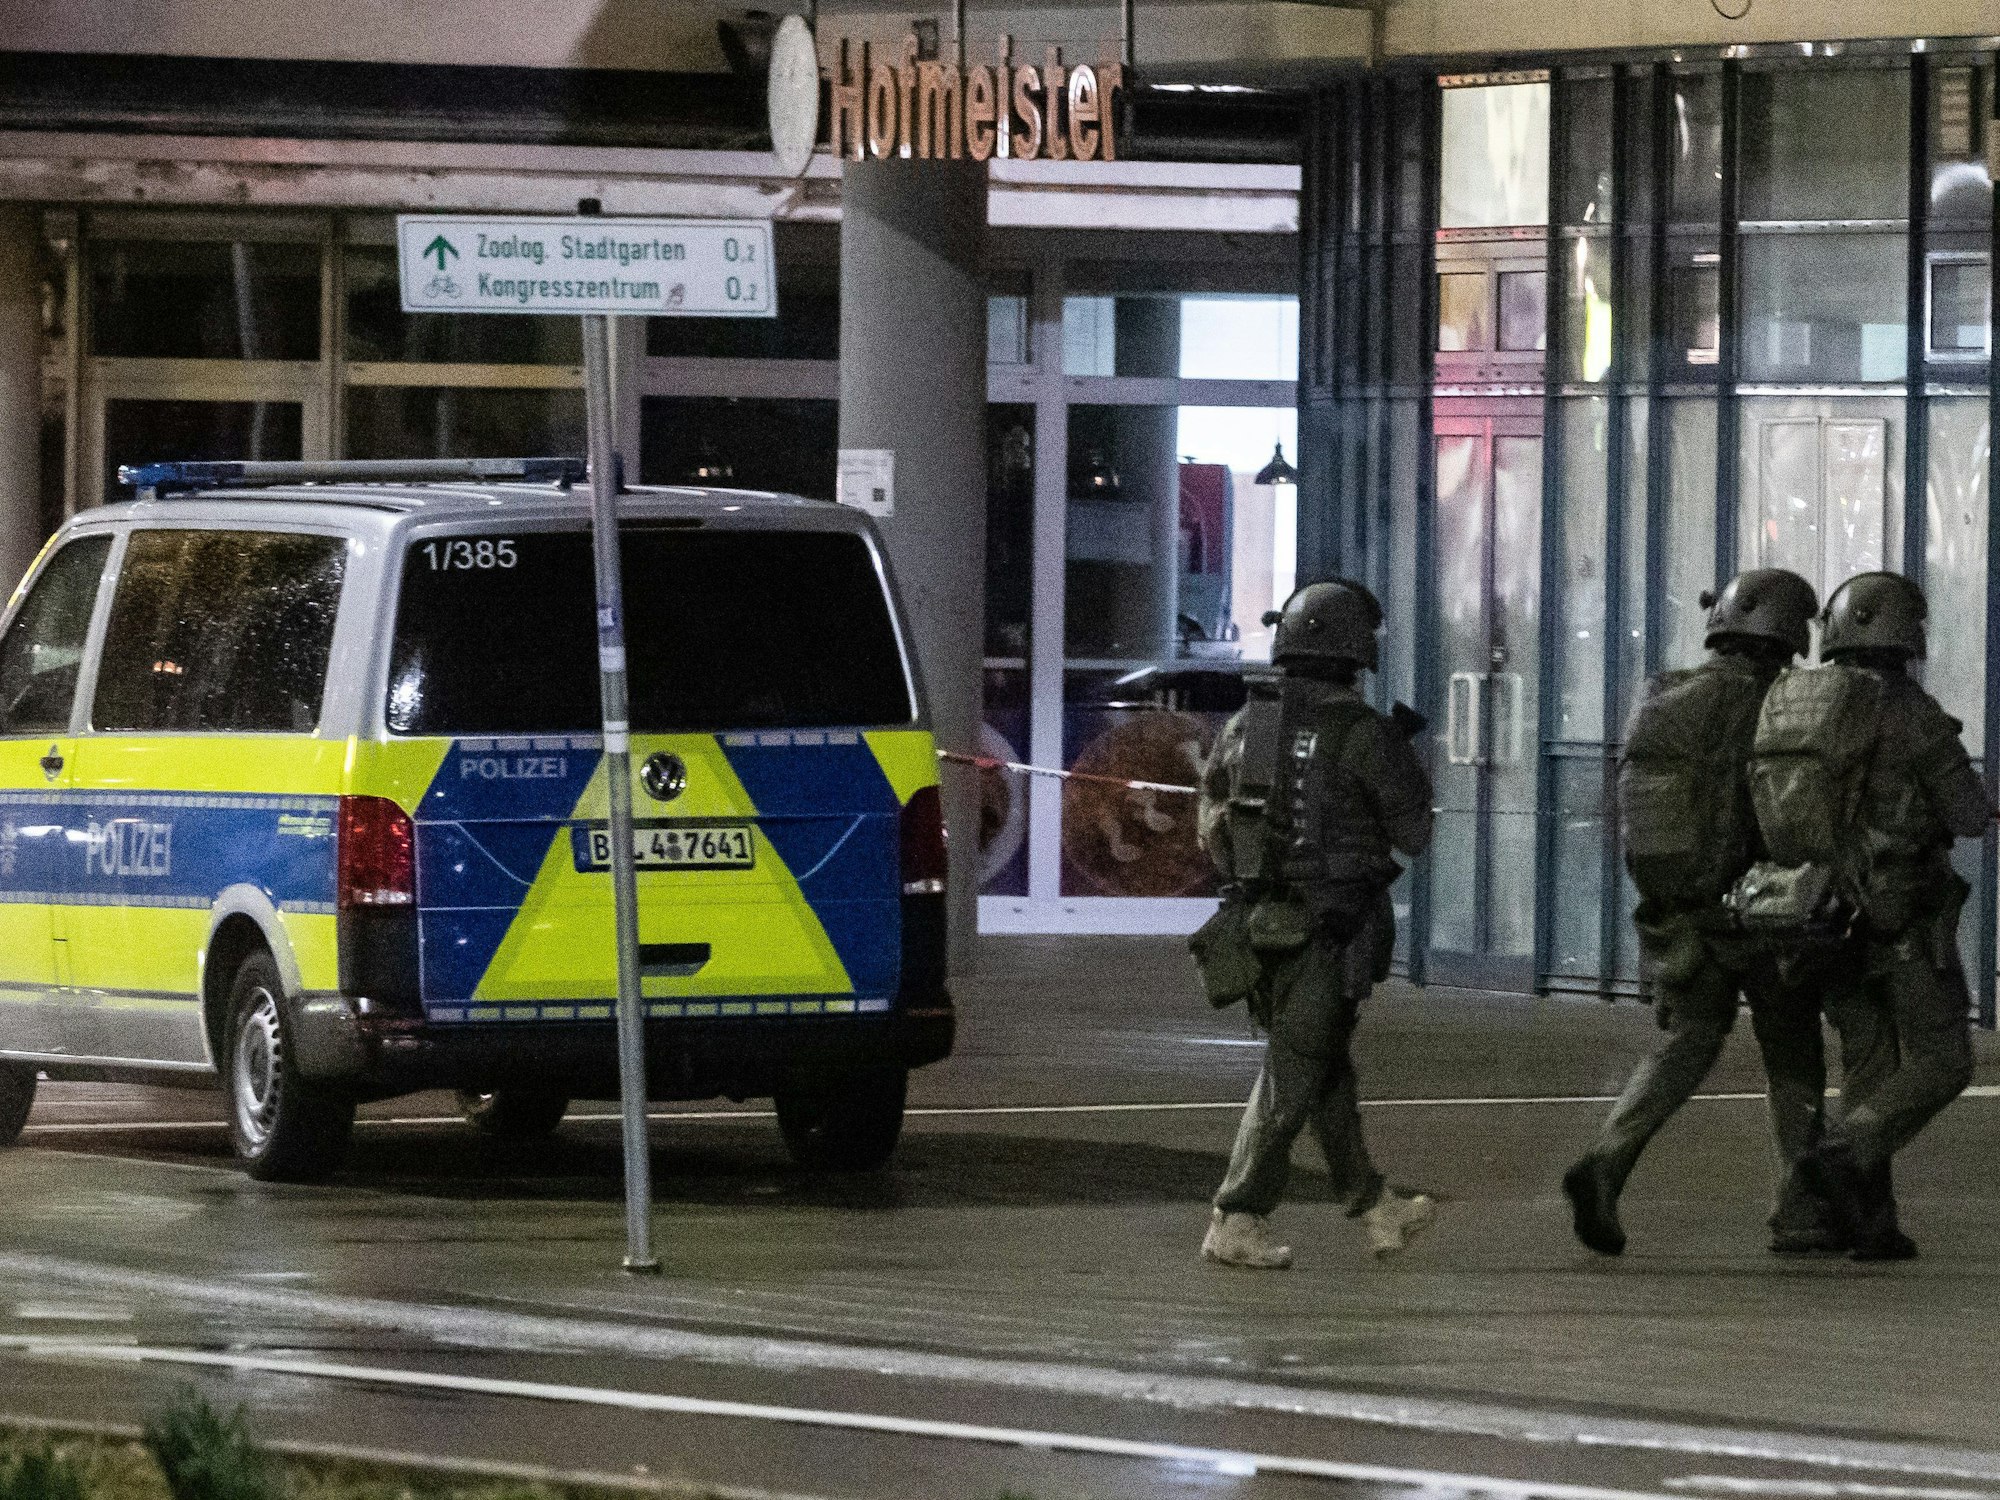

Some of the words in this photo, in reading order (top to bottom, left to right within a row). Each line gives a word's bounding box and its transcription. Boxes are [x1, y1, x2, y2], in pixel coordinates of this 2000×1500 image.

[831, 33, 1122, 161] Hofmeister
[477, 234, 549, 265] Zoolog.
[561, 235, 686, 265] Stadtgarten
[478, 273, 660, 303] Kongresszentrum
[422, 540, 517, 570] 1/385
[460, 757, 567, 779] POLIZEI
[86, 821, 172, 876] POLIZEI
